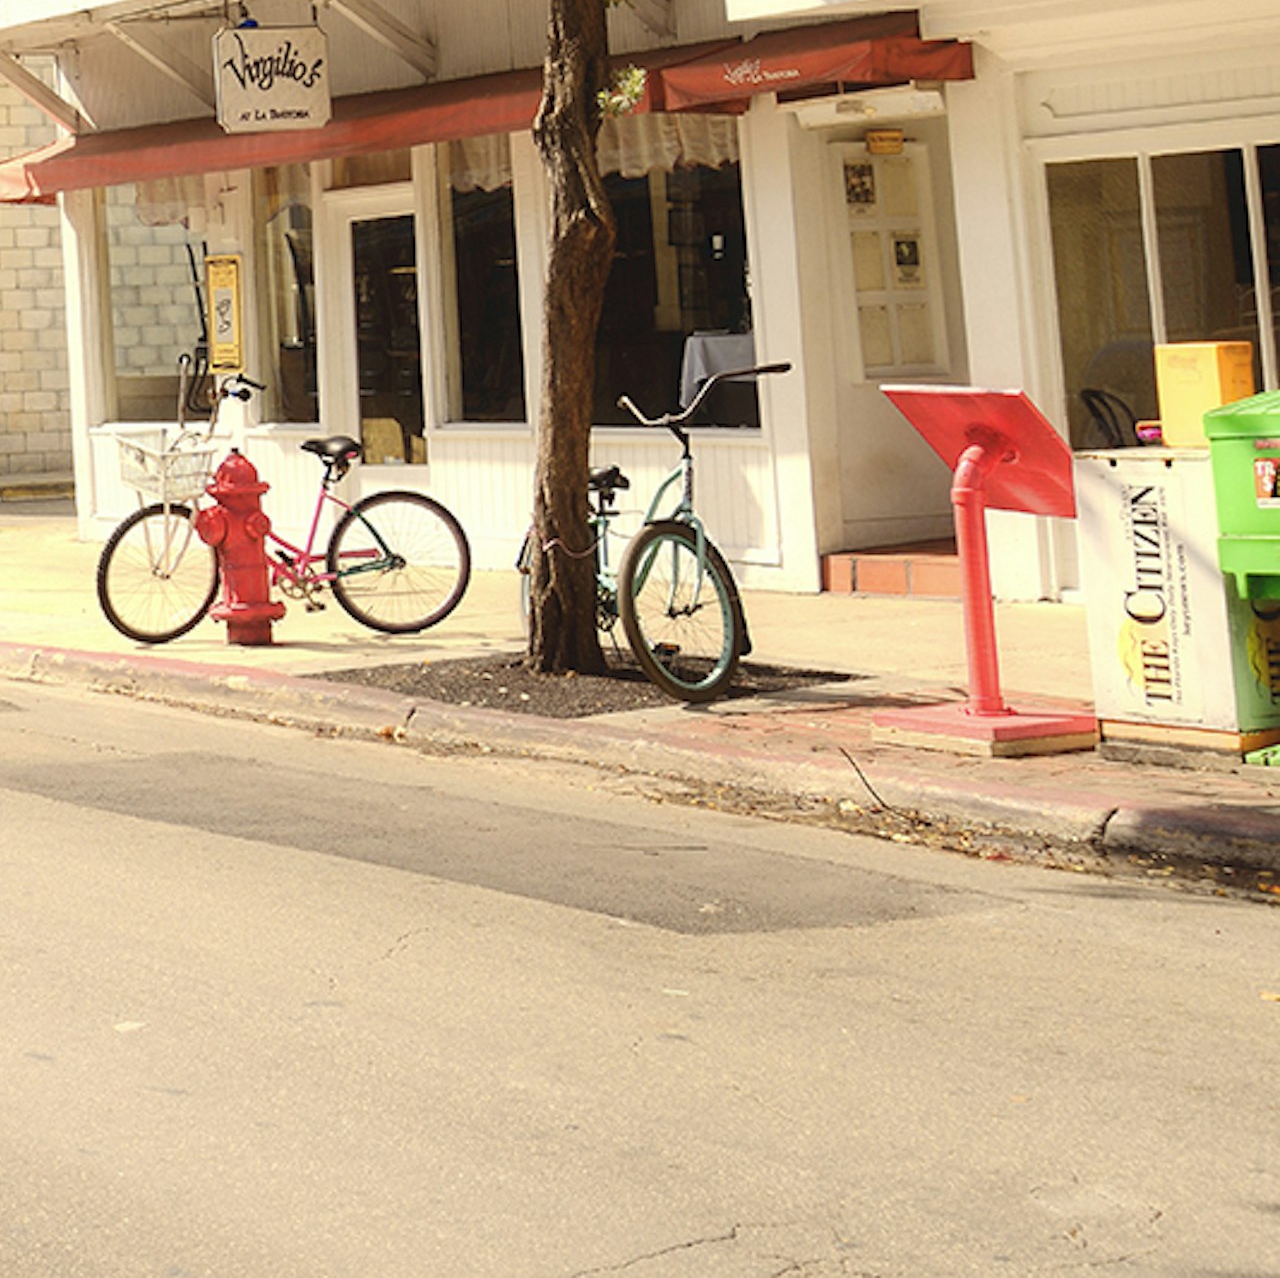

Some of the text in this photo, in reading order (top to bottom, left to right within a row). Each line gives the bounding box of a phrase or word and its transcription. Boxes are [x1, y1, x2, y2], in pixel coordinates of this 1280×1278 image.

[223, 33, 323, 90] Virgilio's
[1124, 485, 1173, 708] THE CITIZEN
